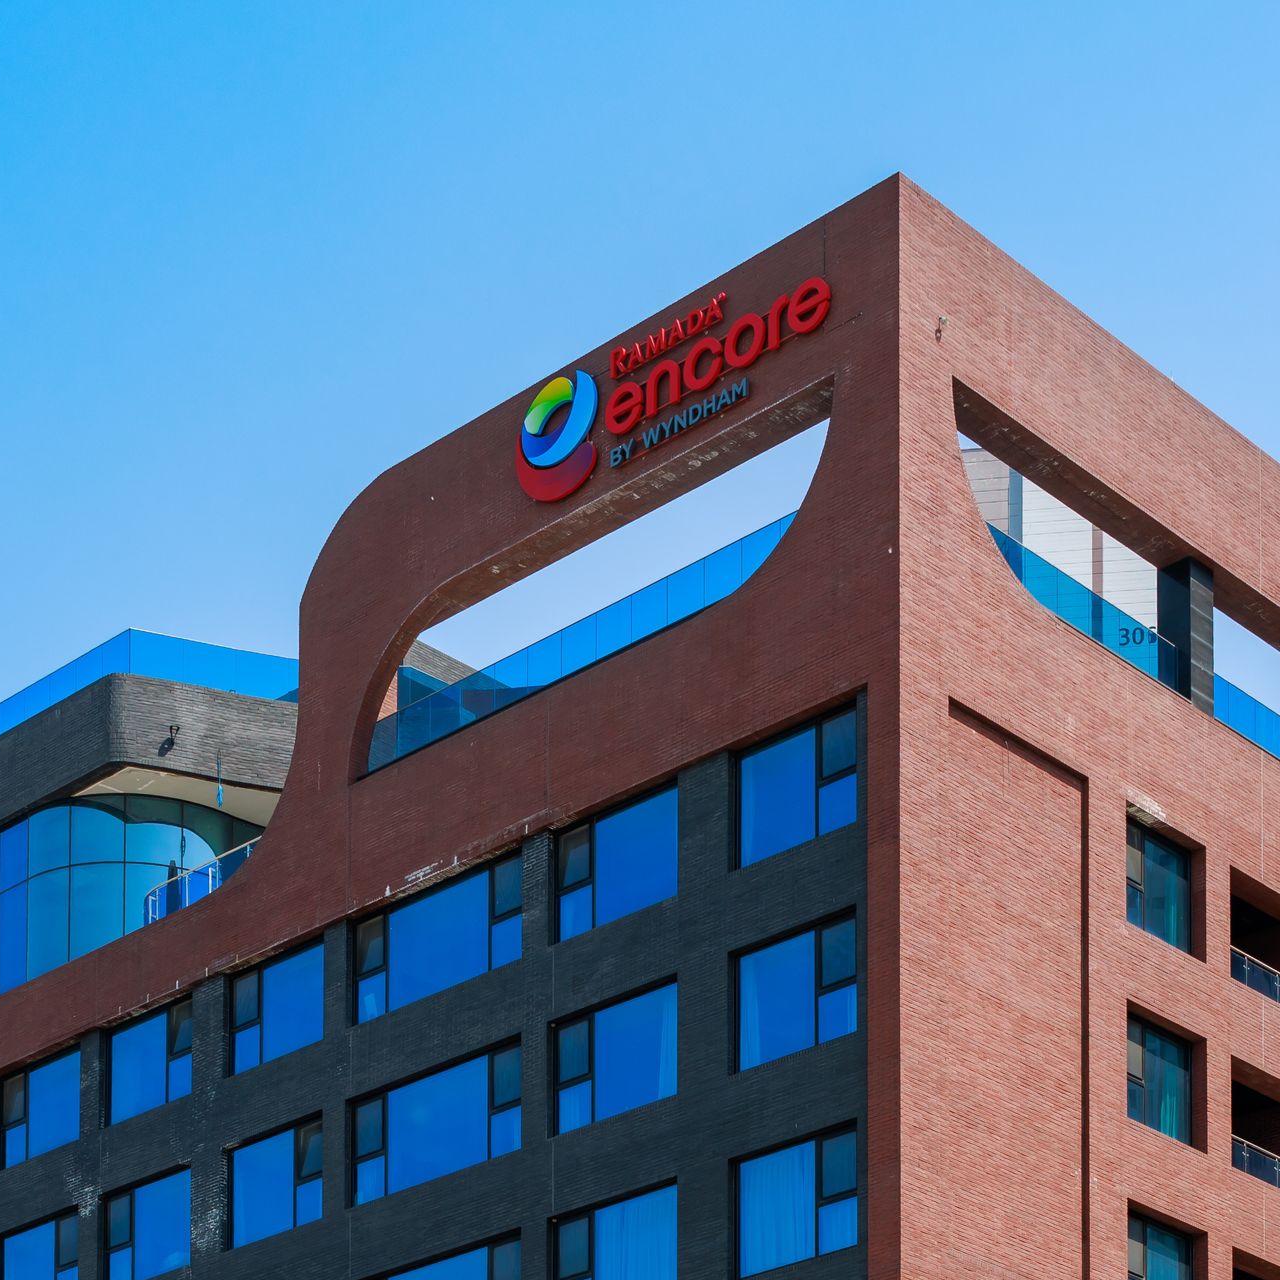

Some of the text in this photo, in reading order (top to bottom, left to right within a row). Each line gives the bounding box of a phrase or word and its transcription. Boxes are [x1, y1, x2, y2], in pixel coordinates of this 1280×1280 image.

[605, 276, 832, 435] encore
[610, 294, 725, 380] RAMADA
[609, 376, 751, 468] BY WYNDHAM
